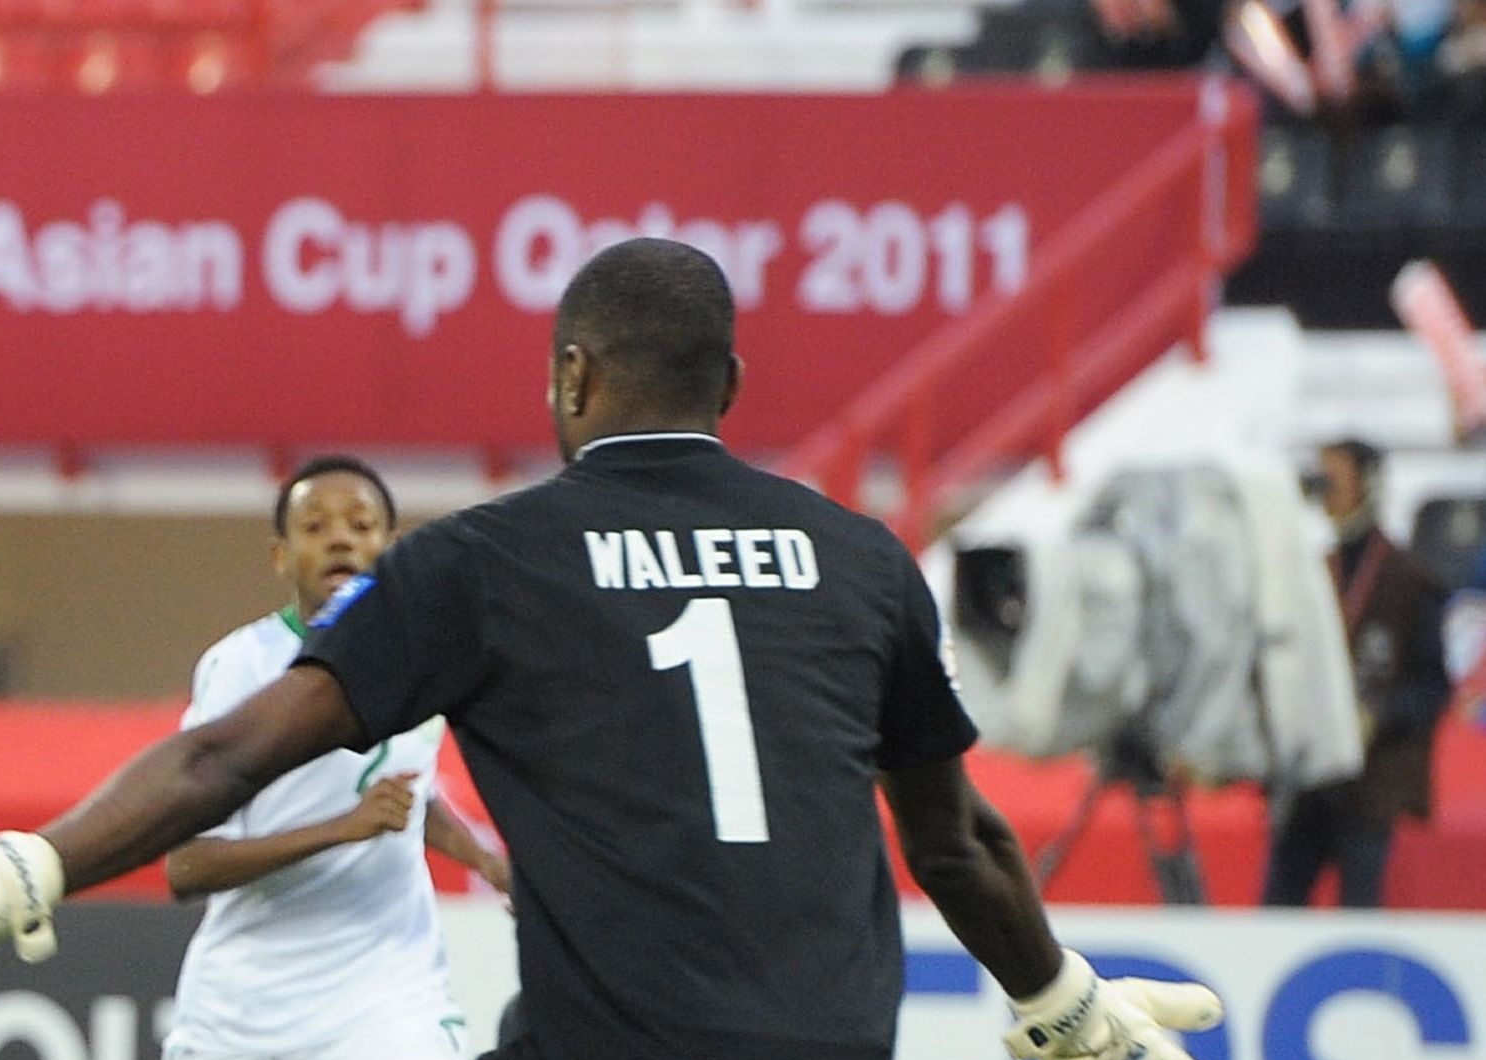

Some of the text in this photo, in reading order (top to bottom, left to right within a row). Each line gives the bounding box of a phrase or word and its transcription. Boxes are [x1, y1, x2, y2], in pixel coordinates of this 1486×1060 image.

[262, 196, 475, 333] Cup
[795, 197, 1030, 314] 2011
[584, 529, 820, 590] WALEED
[646, 597, 771, 843] 1
